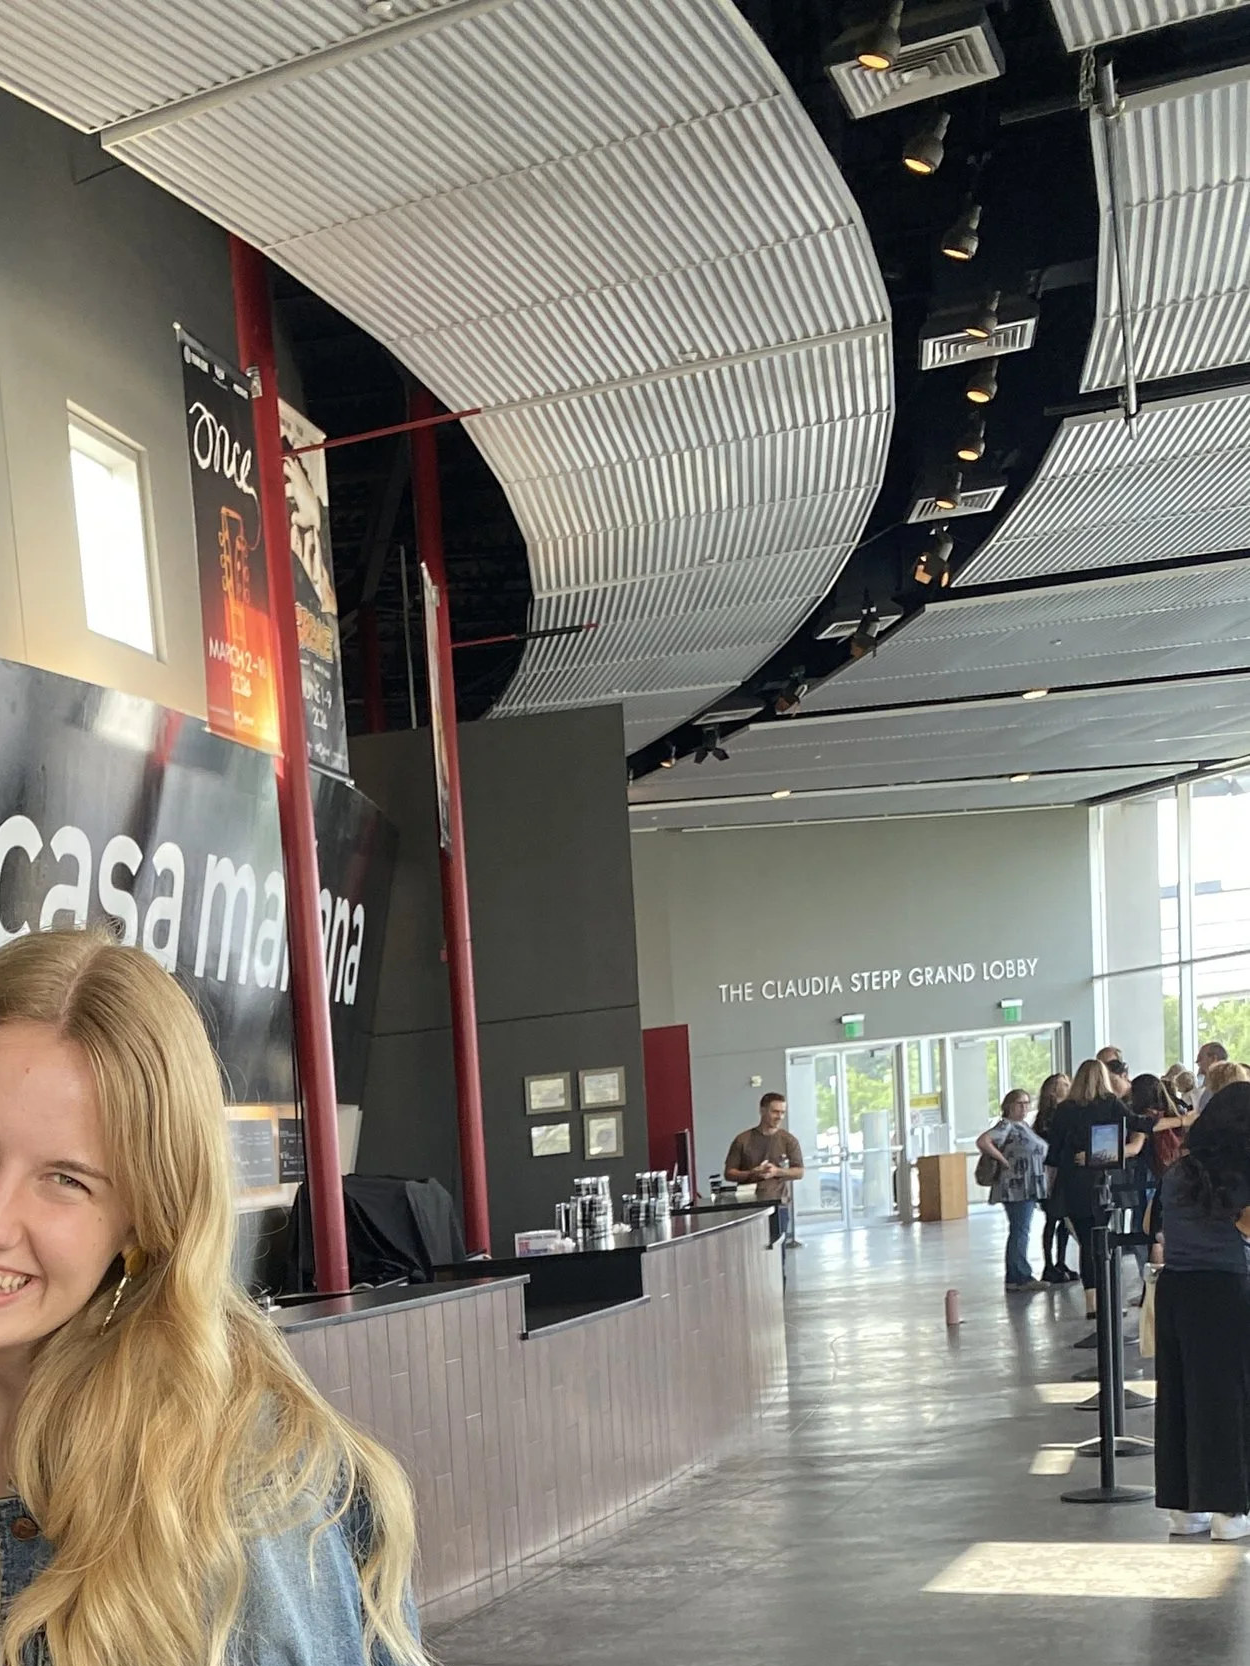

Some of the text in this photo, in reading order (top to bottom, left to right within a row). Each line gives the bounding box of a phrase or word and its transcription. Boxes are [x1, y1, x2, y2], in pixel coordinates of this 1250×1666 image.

[208, 636, 244, 671] MARCH
[718, 957, 1039, 1003] THE CLAUDIA STEPP GRAND LOBBY
